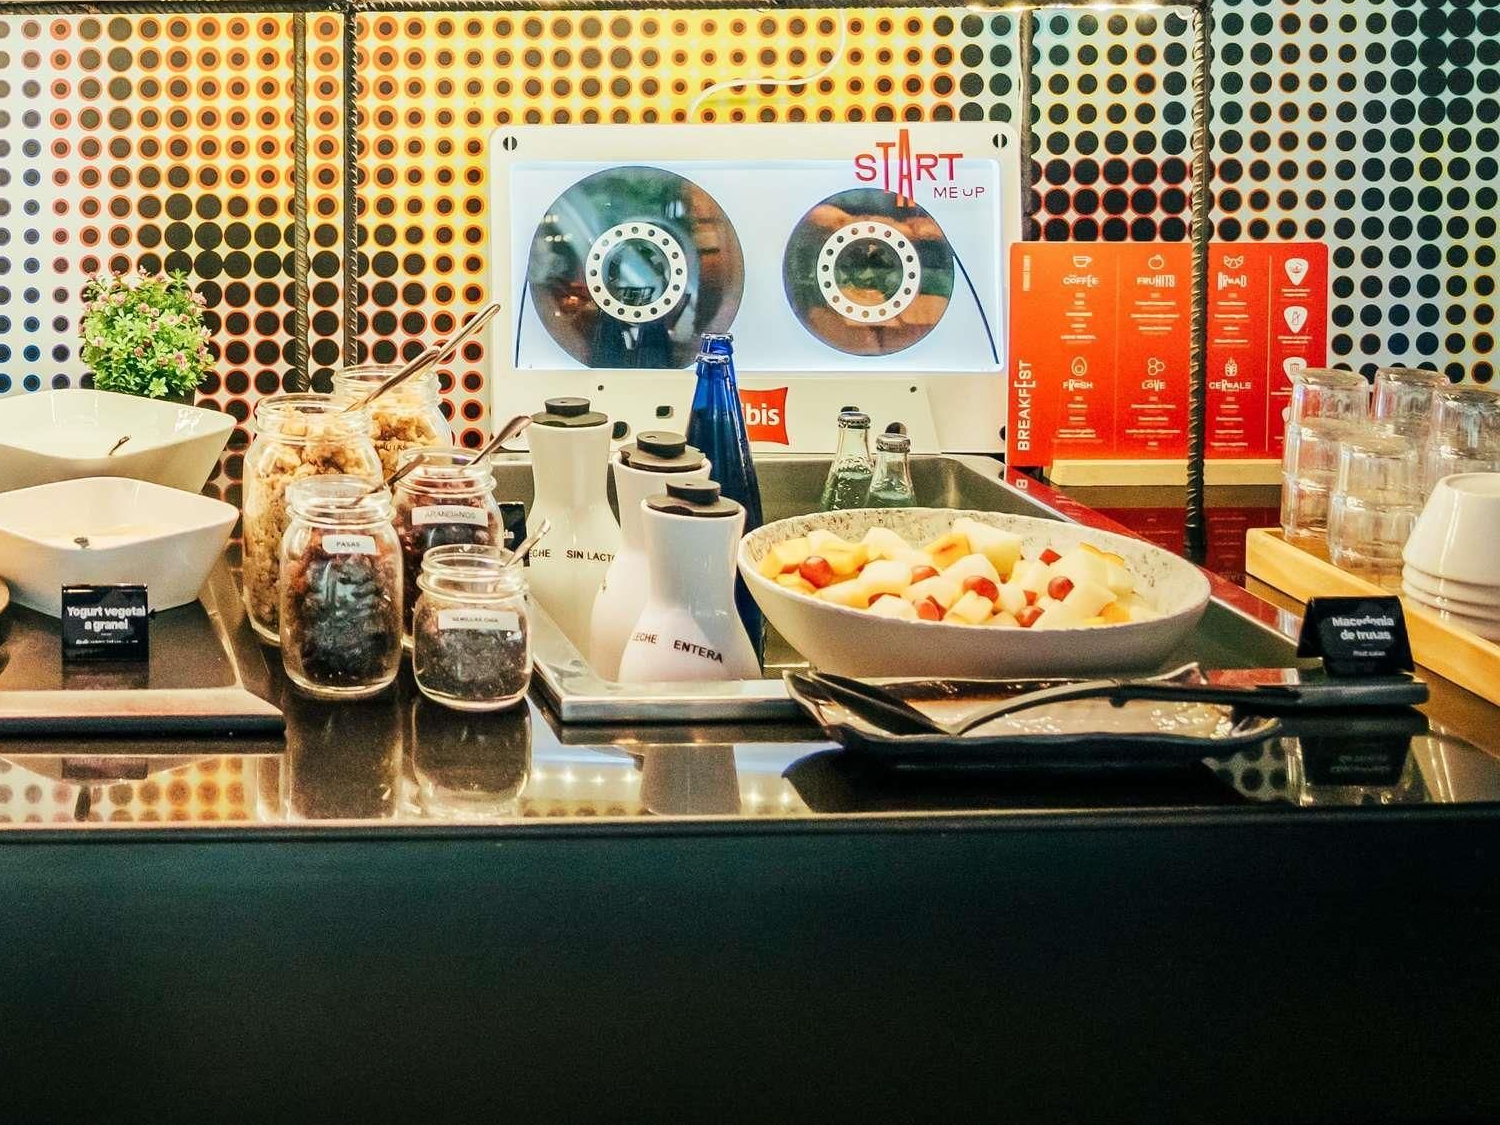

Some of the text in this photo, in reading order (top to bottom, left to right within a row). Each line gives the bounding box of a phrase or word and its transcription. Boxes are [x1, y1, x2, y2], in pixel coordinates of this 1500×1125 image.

[854, 128, 963, 207] START
[933, 186, 985, 199] ME UP
[529, 548, 551, 558] ECHE
[566, 549, 584, 560] SIN
[66, 605, 146, 619] Yogurt vegetal
[84, 618, 129, 632] a granel
[1331, 615, 1395, 627] Macedonia
[1340, 629, 1355, 641] de
[673, 639, 725, 663] ENTERA
